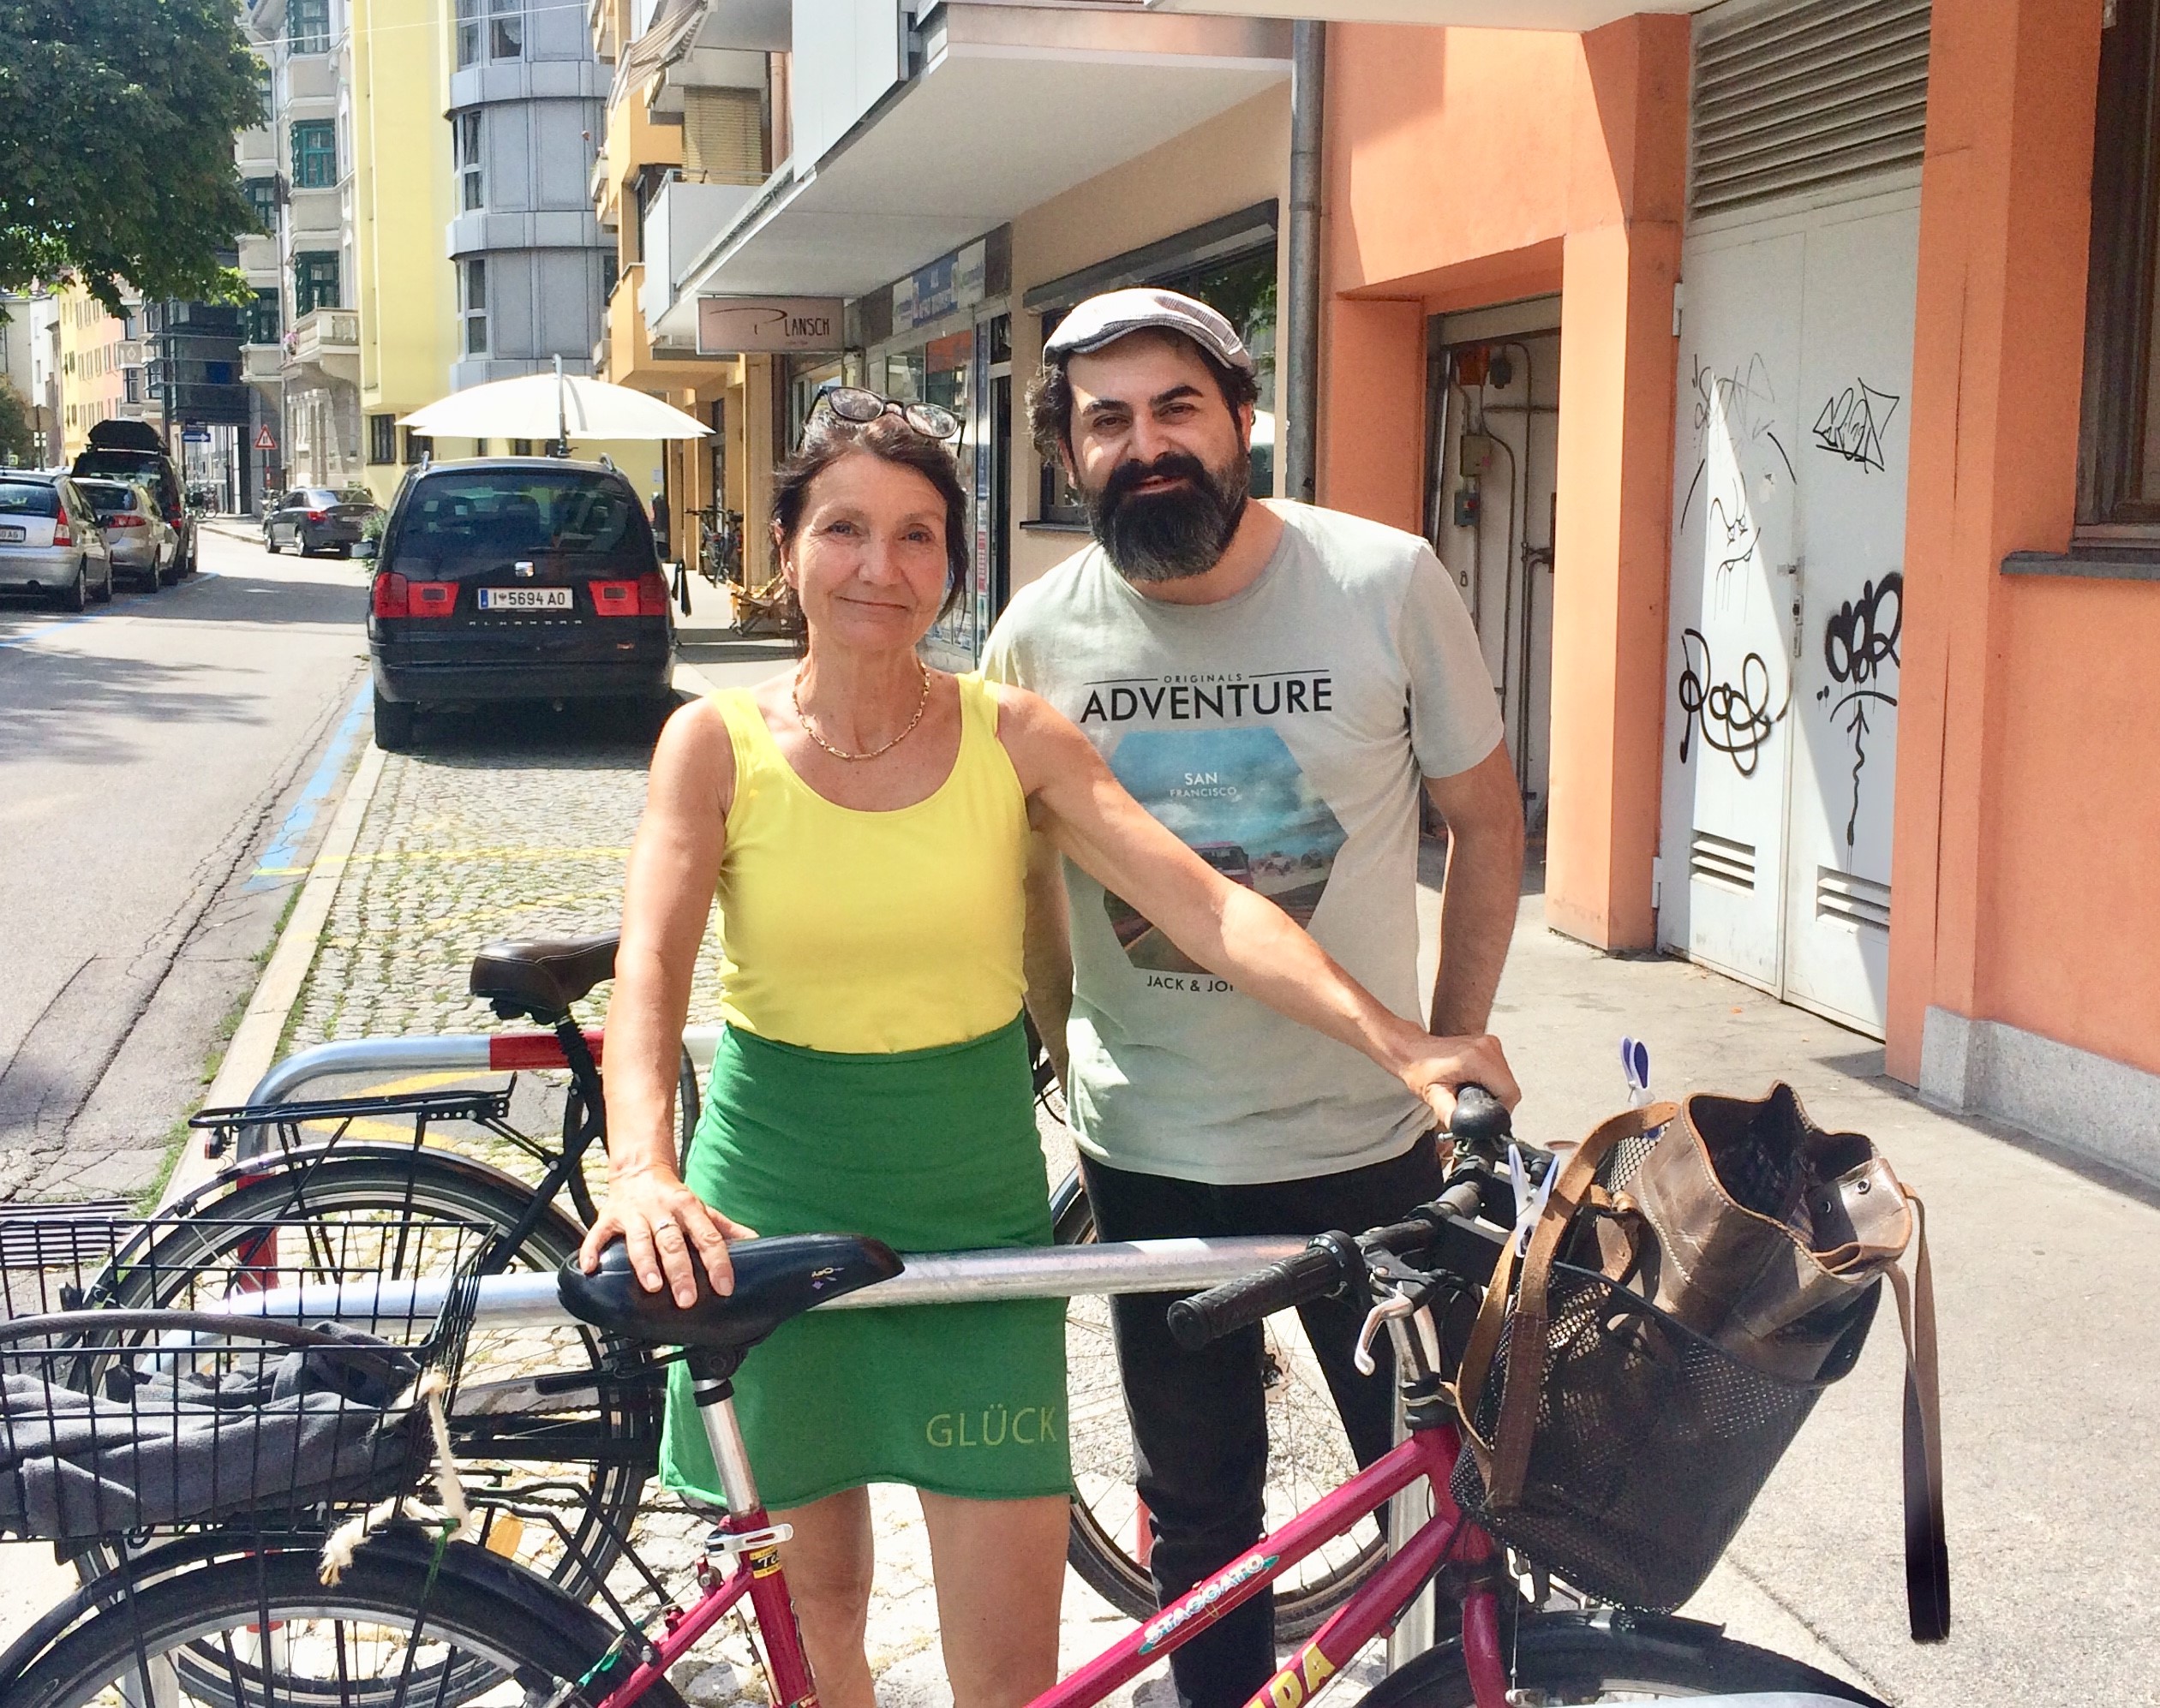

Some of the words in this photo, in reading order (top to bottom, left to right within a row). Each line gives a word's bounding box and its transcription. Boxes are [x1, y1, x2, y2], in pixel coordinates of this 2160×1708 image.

[508, 592, 543, 606] 5694
[1164, 672, 1243, 684] ORIGINALS
[1080, 678, 1333, 723] ADVENTURE
[1184, 772, 1218, 785] SAN
[1169, 786, 1237, 797] FRANCISCO
[1146, 975, 1184, 991] JACK
[1189, 979, 1200, 992] &
[926, 1403, 1057, 1448] GLÜCK
